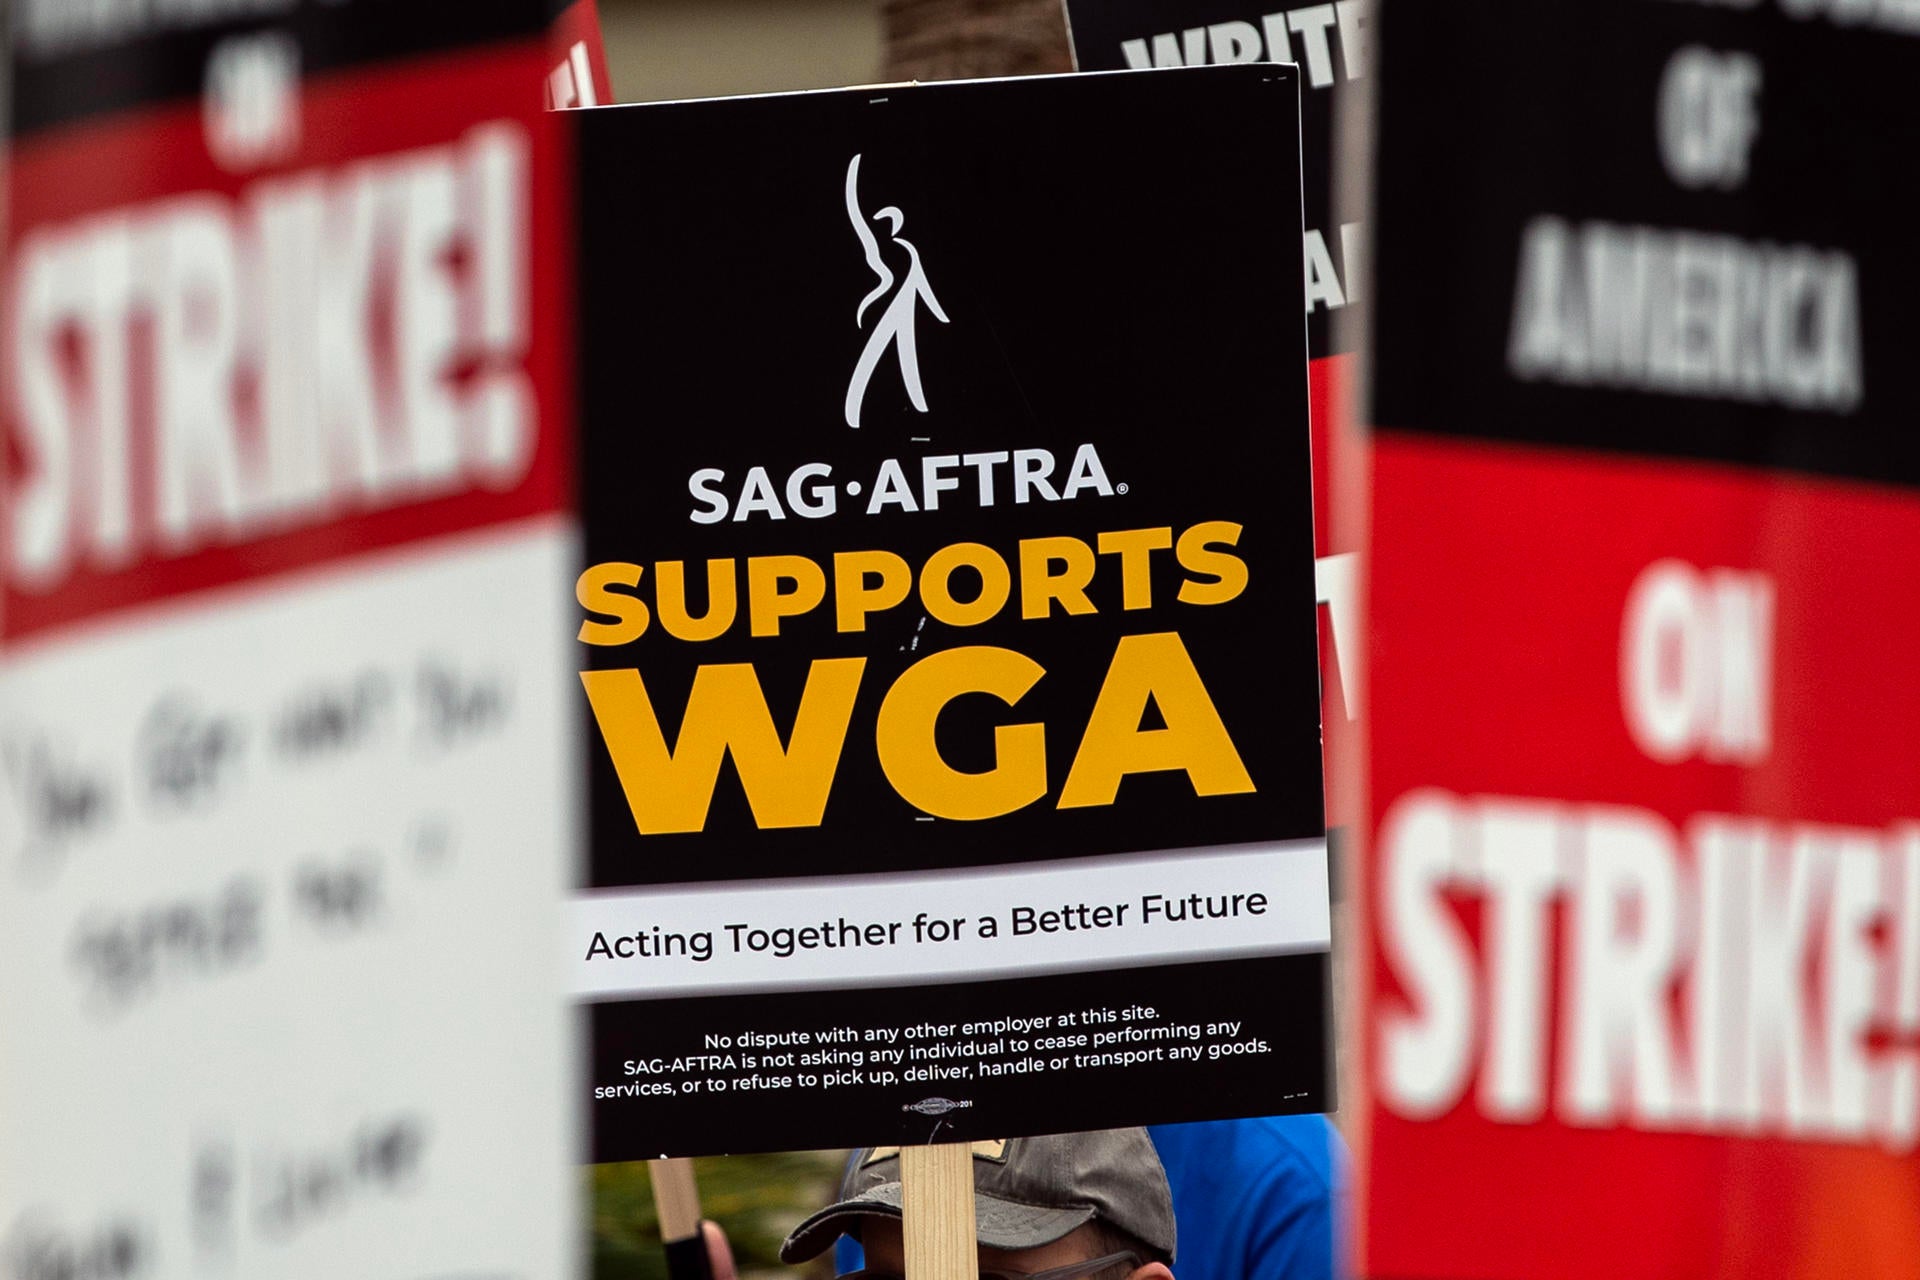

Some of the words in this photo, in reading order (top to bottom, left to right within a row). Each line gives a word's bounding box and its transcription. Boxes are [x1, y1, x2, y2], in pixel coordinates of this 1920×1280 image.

[1659, 47, 1761, 190] OF
[9, 122, 535, 588] STRIKE!
[1508, 217, 1862, 412] AMERICA
[576, 521, 1249, 646] SUPPORTS
[1622, 560, 1774, 764] ON
[580, 632, 1257, 835] WGA
[585, 926, 713, 962] Acting
[724, 917, 902, 958] Together
[912, 912, 966, 943] for
[978, 915, 998, 939] a
[1012, 903, 1129, 936] Better
[1142, 893, 1268, 924] Future
[594, 1080, 677, 1099] services,
[681, 1080, 702, 1094] or
[706, 1078, 727, 1092] to
[732, 1073, 793, 1091] refuse
[797, 1073, 818, 1087] to
[823, 1069, 864, 1089] pick
[869, 1071, 899, 1087] up,
[903, 1064, 974, 1082] deliver,
[979, 1056, 1045, 1077] handle
[1049, 1057, 1070, 1070] or
[1074, 1047, 1164, 1068] transport
[1168, 1044, 1203, 1062] any
[1207, 1037, 1272, 1059] goods.
[623, 1054, 737, 1076] SAG-AFTRA
[741, 1052, 757, 1069] is
[762, 1052, 795, 1068] not
[800, 1048, 864, 1067] asking
[869, 1048, 905, 1065] any
[909, 1038, 1004, 1060] individual
[1009, 1039, 1029, 1053] to
[1034, 1034, 1088, 1050] cease
[1093, 1022, 1201, 1049] performing
[1206, 1021, 1241, 1038] any
[704, 1033, 732, 1049] No
[737, 1030, 811, 1050] dispute
[815, 1026, 859, 1044] with
[864, 1027, 900, 1044] any
[904, 1022, 957, 1039] other
[961, 1016, 1053, 1036] employer
[1057, 1012, 1077, 1027] at
[1081, 1007, 1117, 1025] this
[1121, 1004, 1160, 1021] site.
